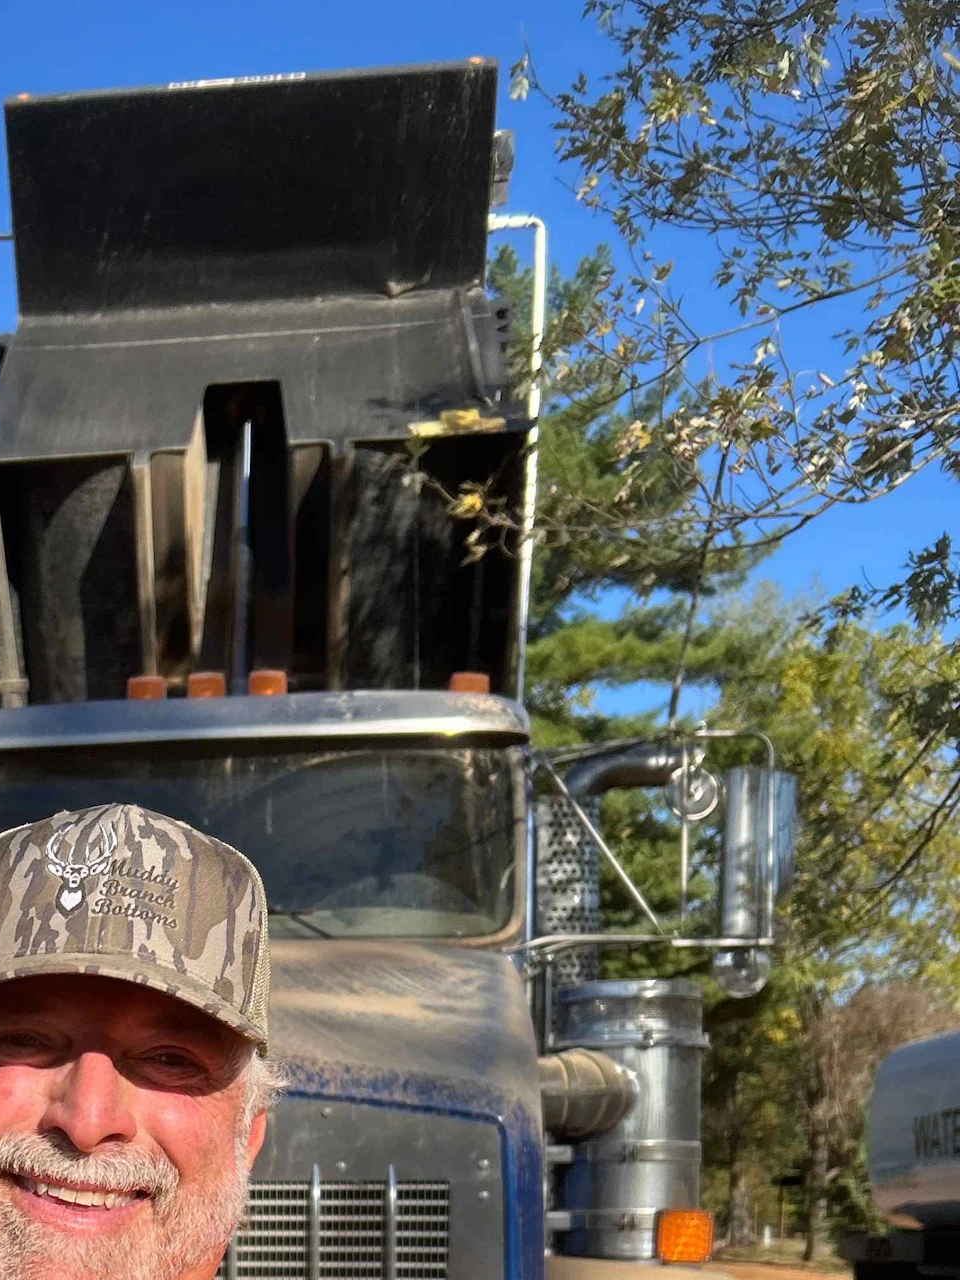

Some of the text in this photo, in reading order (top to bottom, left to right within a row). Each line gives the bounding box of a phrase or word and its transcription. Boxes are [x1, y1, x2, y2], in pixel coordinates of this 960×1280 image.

[101, 859, 179, 893] Muddy
[99, 879, 176, 910] Branch
[92, 898, 178, 929] Bottoms
